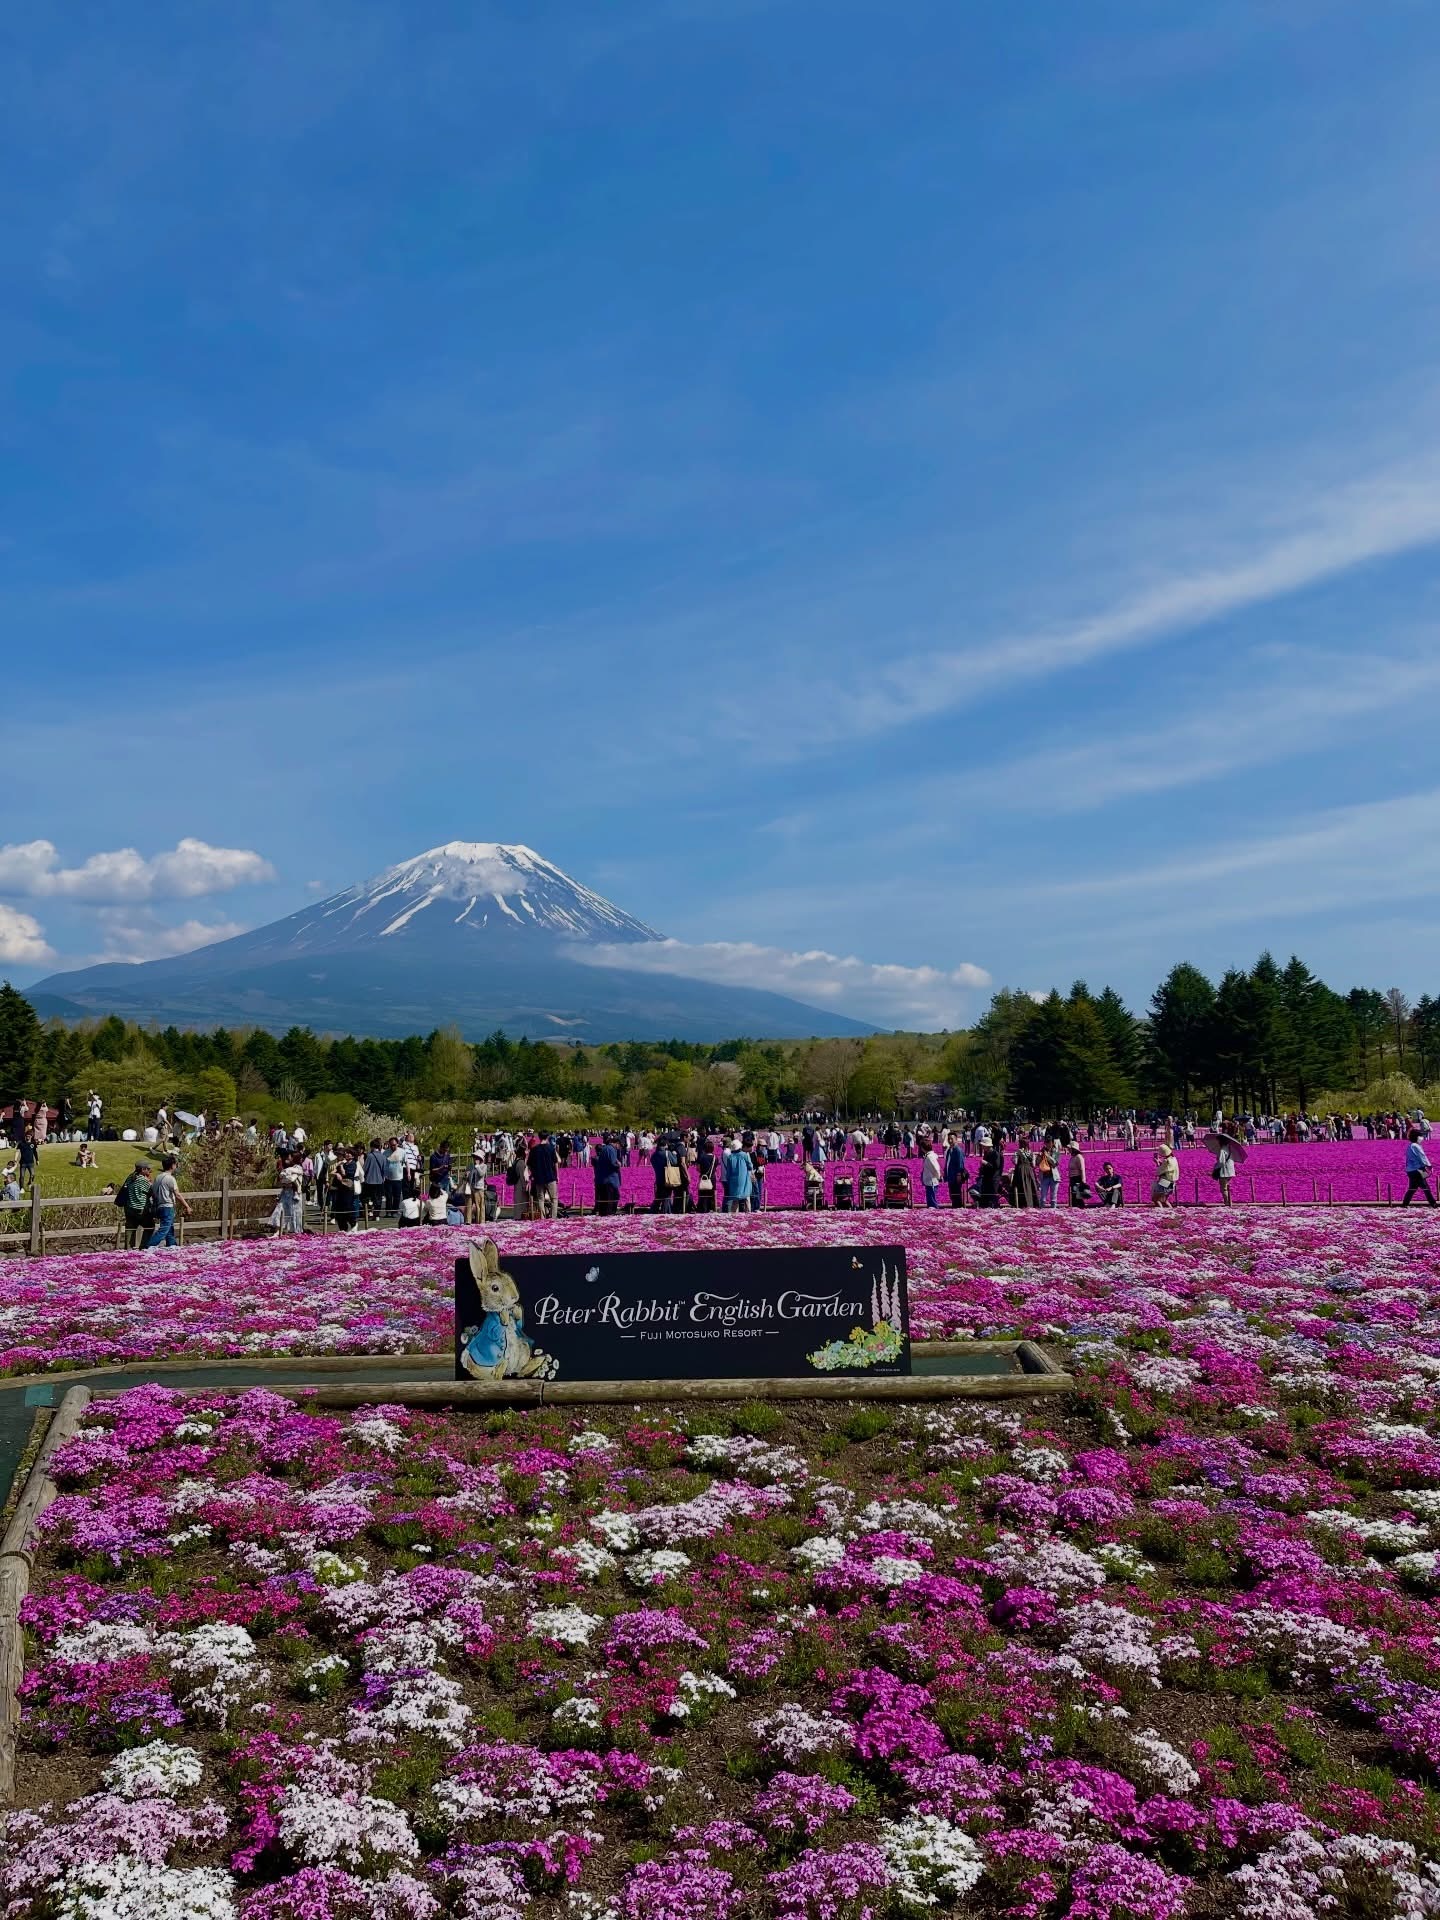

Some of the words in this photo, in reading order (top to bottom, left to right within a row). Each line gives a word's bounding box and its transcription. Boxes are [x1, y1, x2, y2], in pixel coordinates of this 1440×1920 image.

[535, 1293, 596, 1325] Peter
[690, 1292, 774, 1326] English
[777, 1289, 864, 1319] Garden
